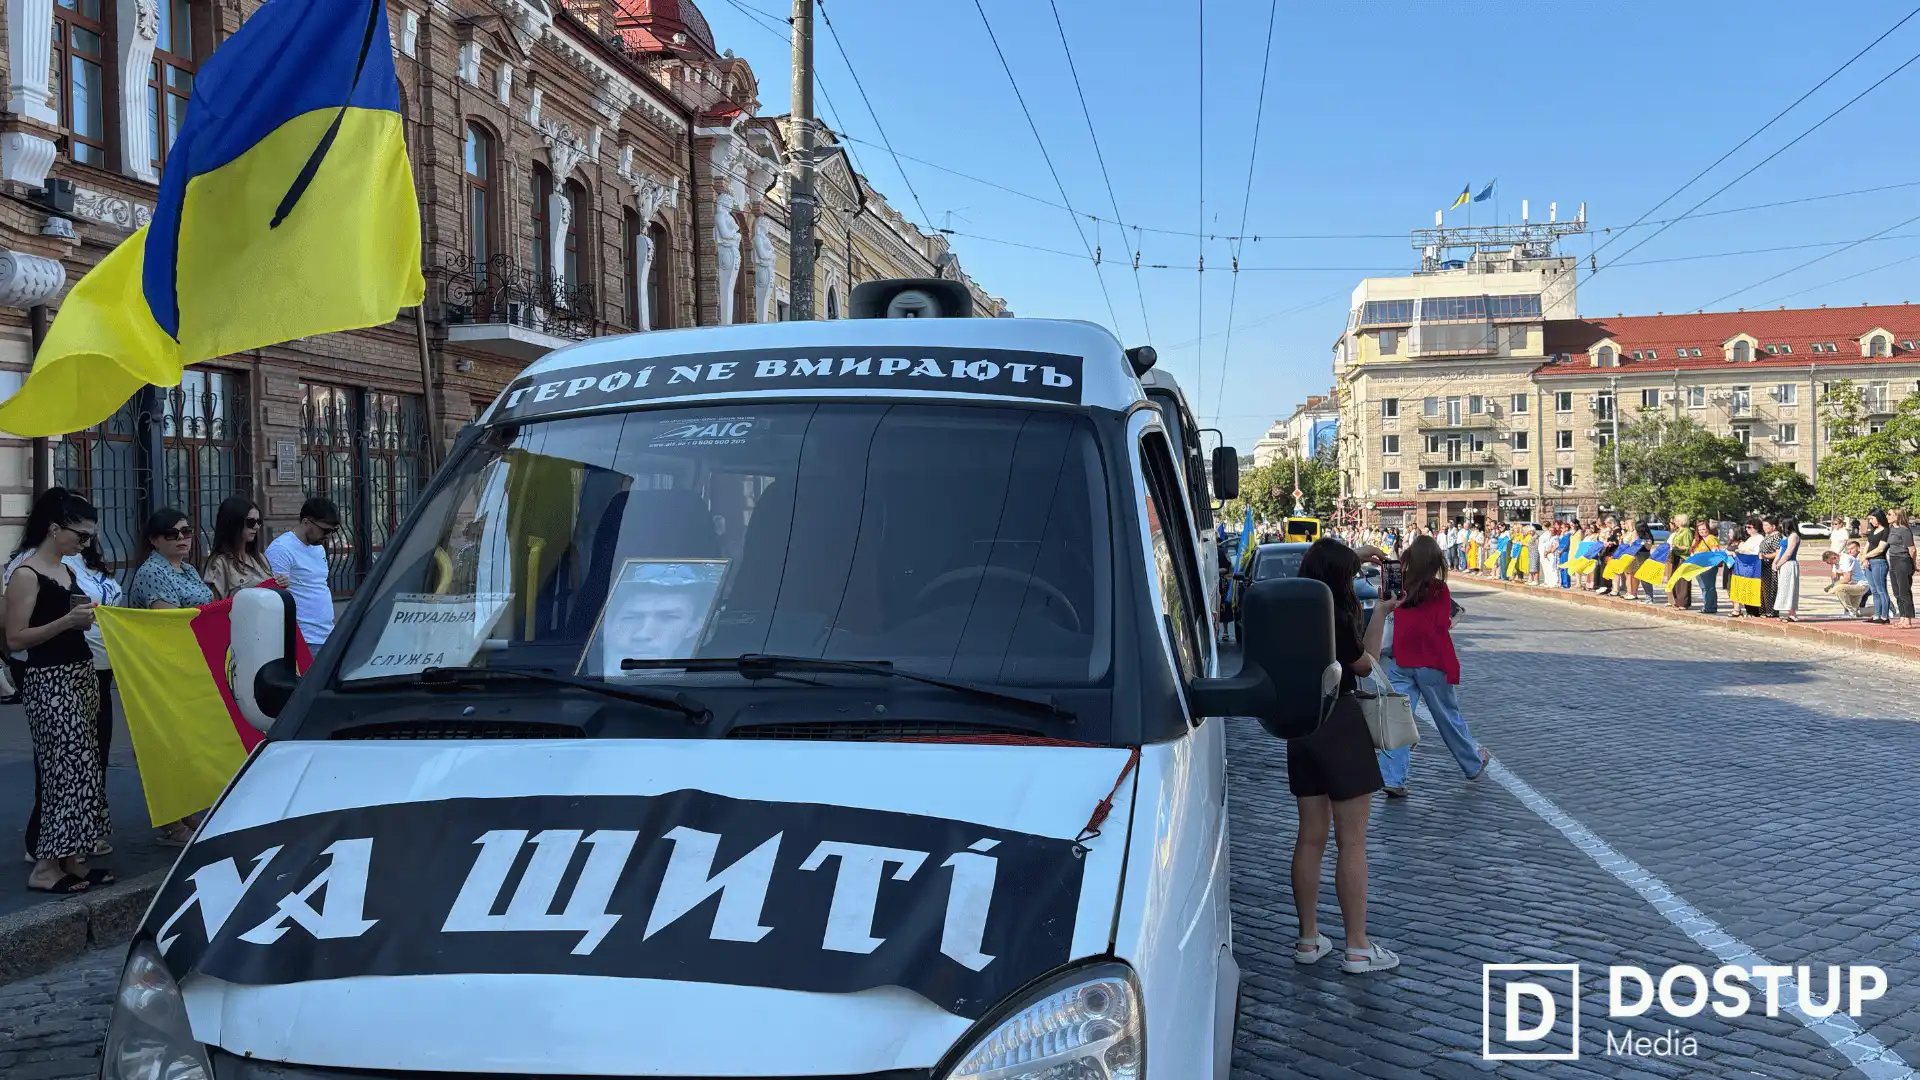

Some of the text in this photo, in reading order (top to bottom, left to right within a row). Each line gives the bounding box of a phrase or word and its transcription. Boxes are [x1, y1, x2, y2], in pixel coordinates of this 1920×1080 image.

[505, 365, 655, 409] ГЕРОЇ
[754, 357, 1073, 388] ВМИРАЮТЬ
[393, 610, 477, 624] РИТУАЛЬНА
[370, 652, 445, 667] СЛУЖБА
[441, 825, 1002, 972] ЩИТІ
